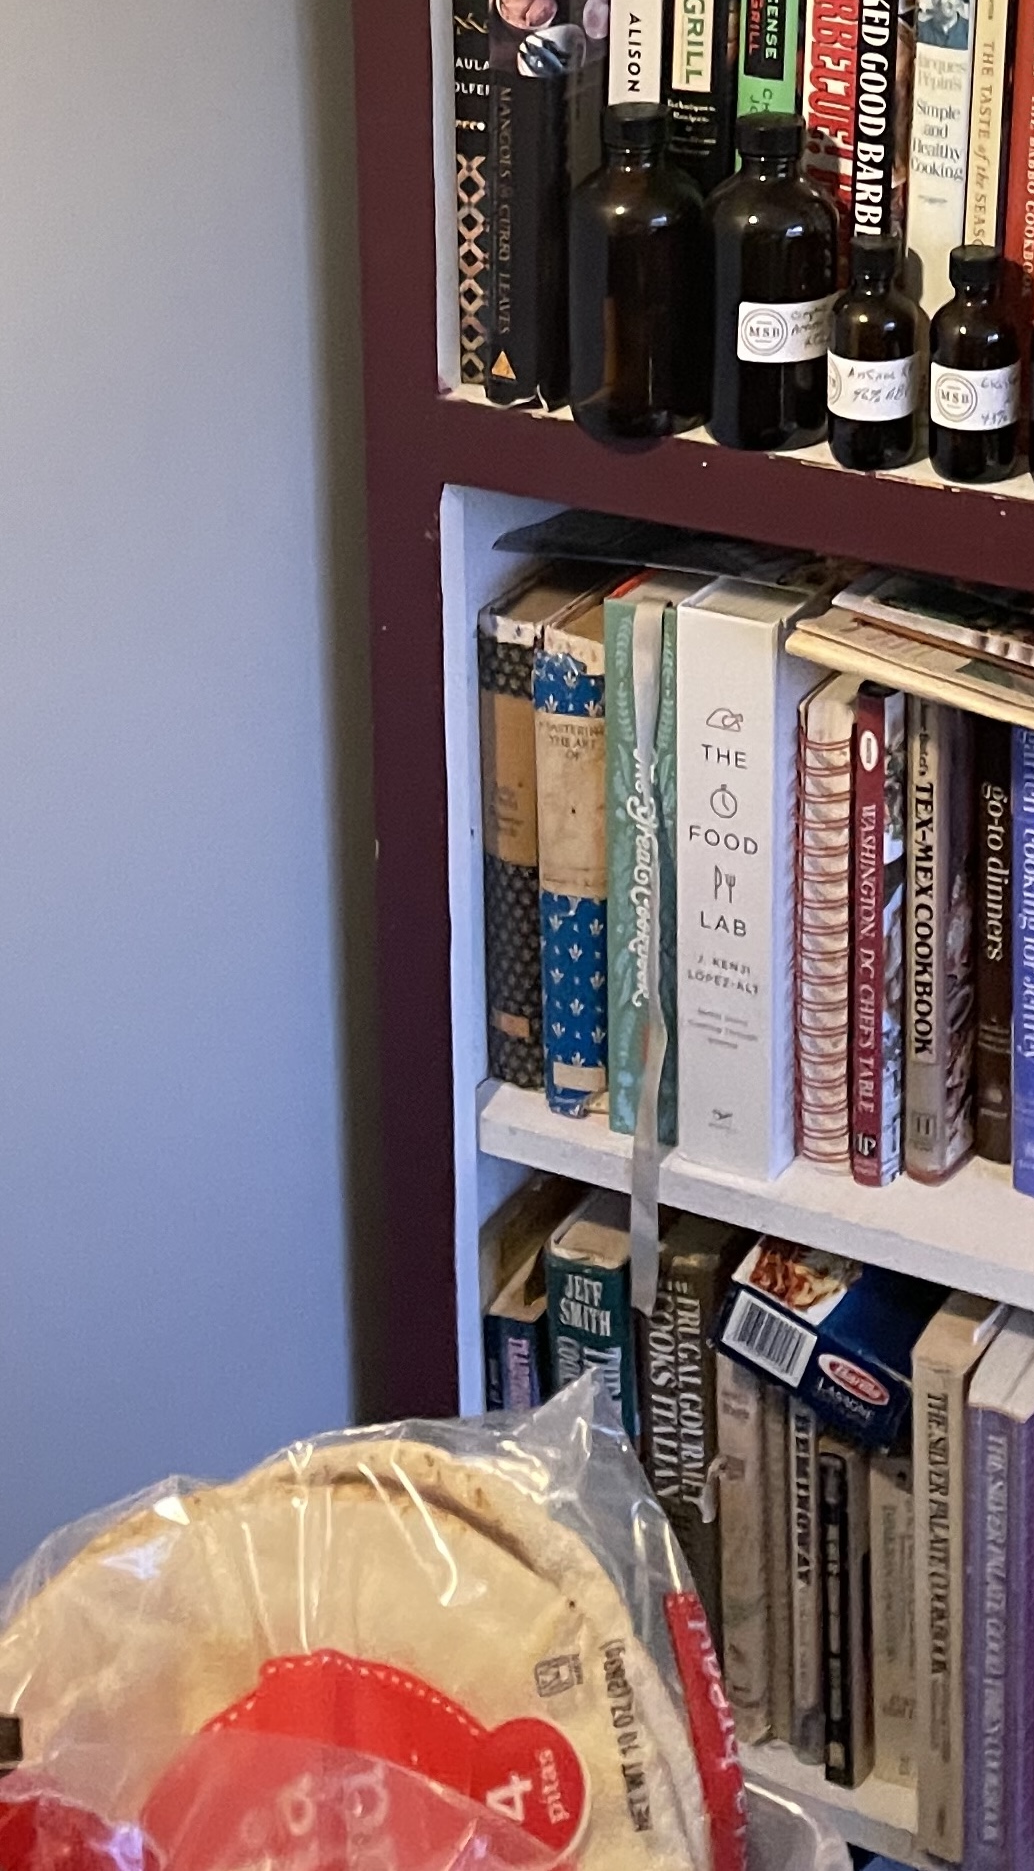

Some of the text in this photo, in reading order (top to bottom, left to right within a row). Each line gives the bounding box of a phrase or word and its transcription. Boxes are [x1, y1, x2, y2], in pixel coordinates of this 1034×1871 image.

[627, 12, 642, 93] ALISON
[858, 53, 889, 138] GOOD
[917, 100, 961, 121] Simple
[976, 41, 994, 189] THE TASTE of the
[911, 137, 963, 162] Healthy
[923, 122, 948, 139] and
[911, 157, 964, 182] Cooking
[549, 735, 596, 750] THE ART
[564, 751, 579, 761] OF
[701, 744, 748, 770] THE
[688, 825, 759, 855] FOOD
[915, 782, 934, 900] TEX-MEX
[982, 782, 1010, 962] go-to dinners
[700, 910, 747, 937] LAB
[712, 957, 751, 974] KENJI
[860, 948, 876, 979] DC
[914, 904, 934, 1055] COOKBOOK
[858, 1057, 875, 1114] TABLE
[565, 1274, 602, 1306] JEFF
[559, 1298, 611, 1337] SMITH
[650, 1296, 679, 1499] COOKS ITALIAN
[677, 1295, 706, 1505] FRUGAL GOURMET
[928, 1393, 948, 1432] THE
[928, 1434, 949, 1496] SILVER
[928, 1499, 950, 1568] PALATE
[610, 1700, 634, 1729] OZ
[487, 1750, 570, 1824] 4 pitas
